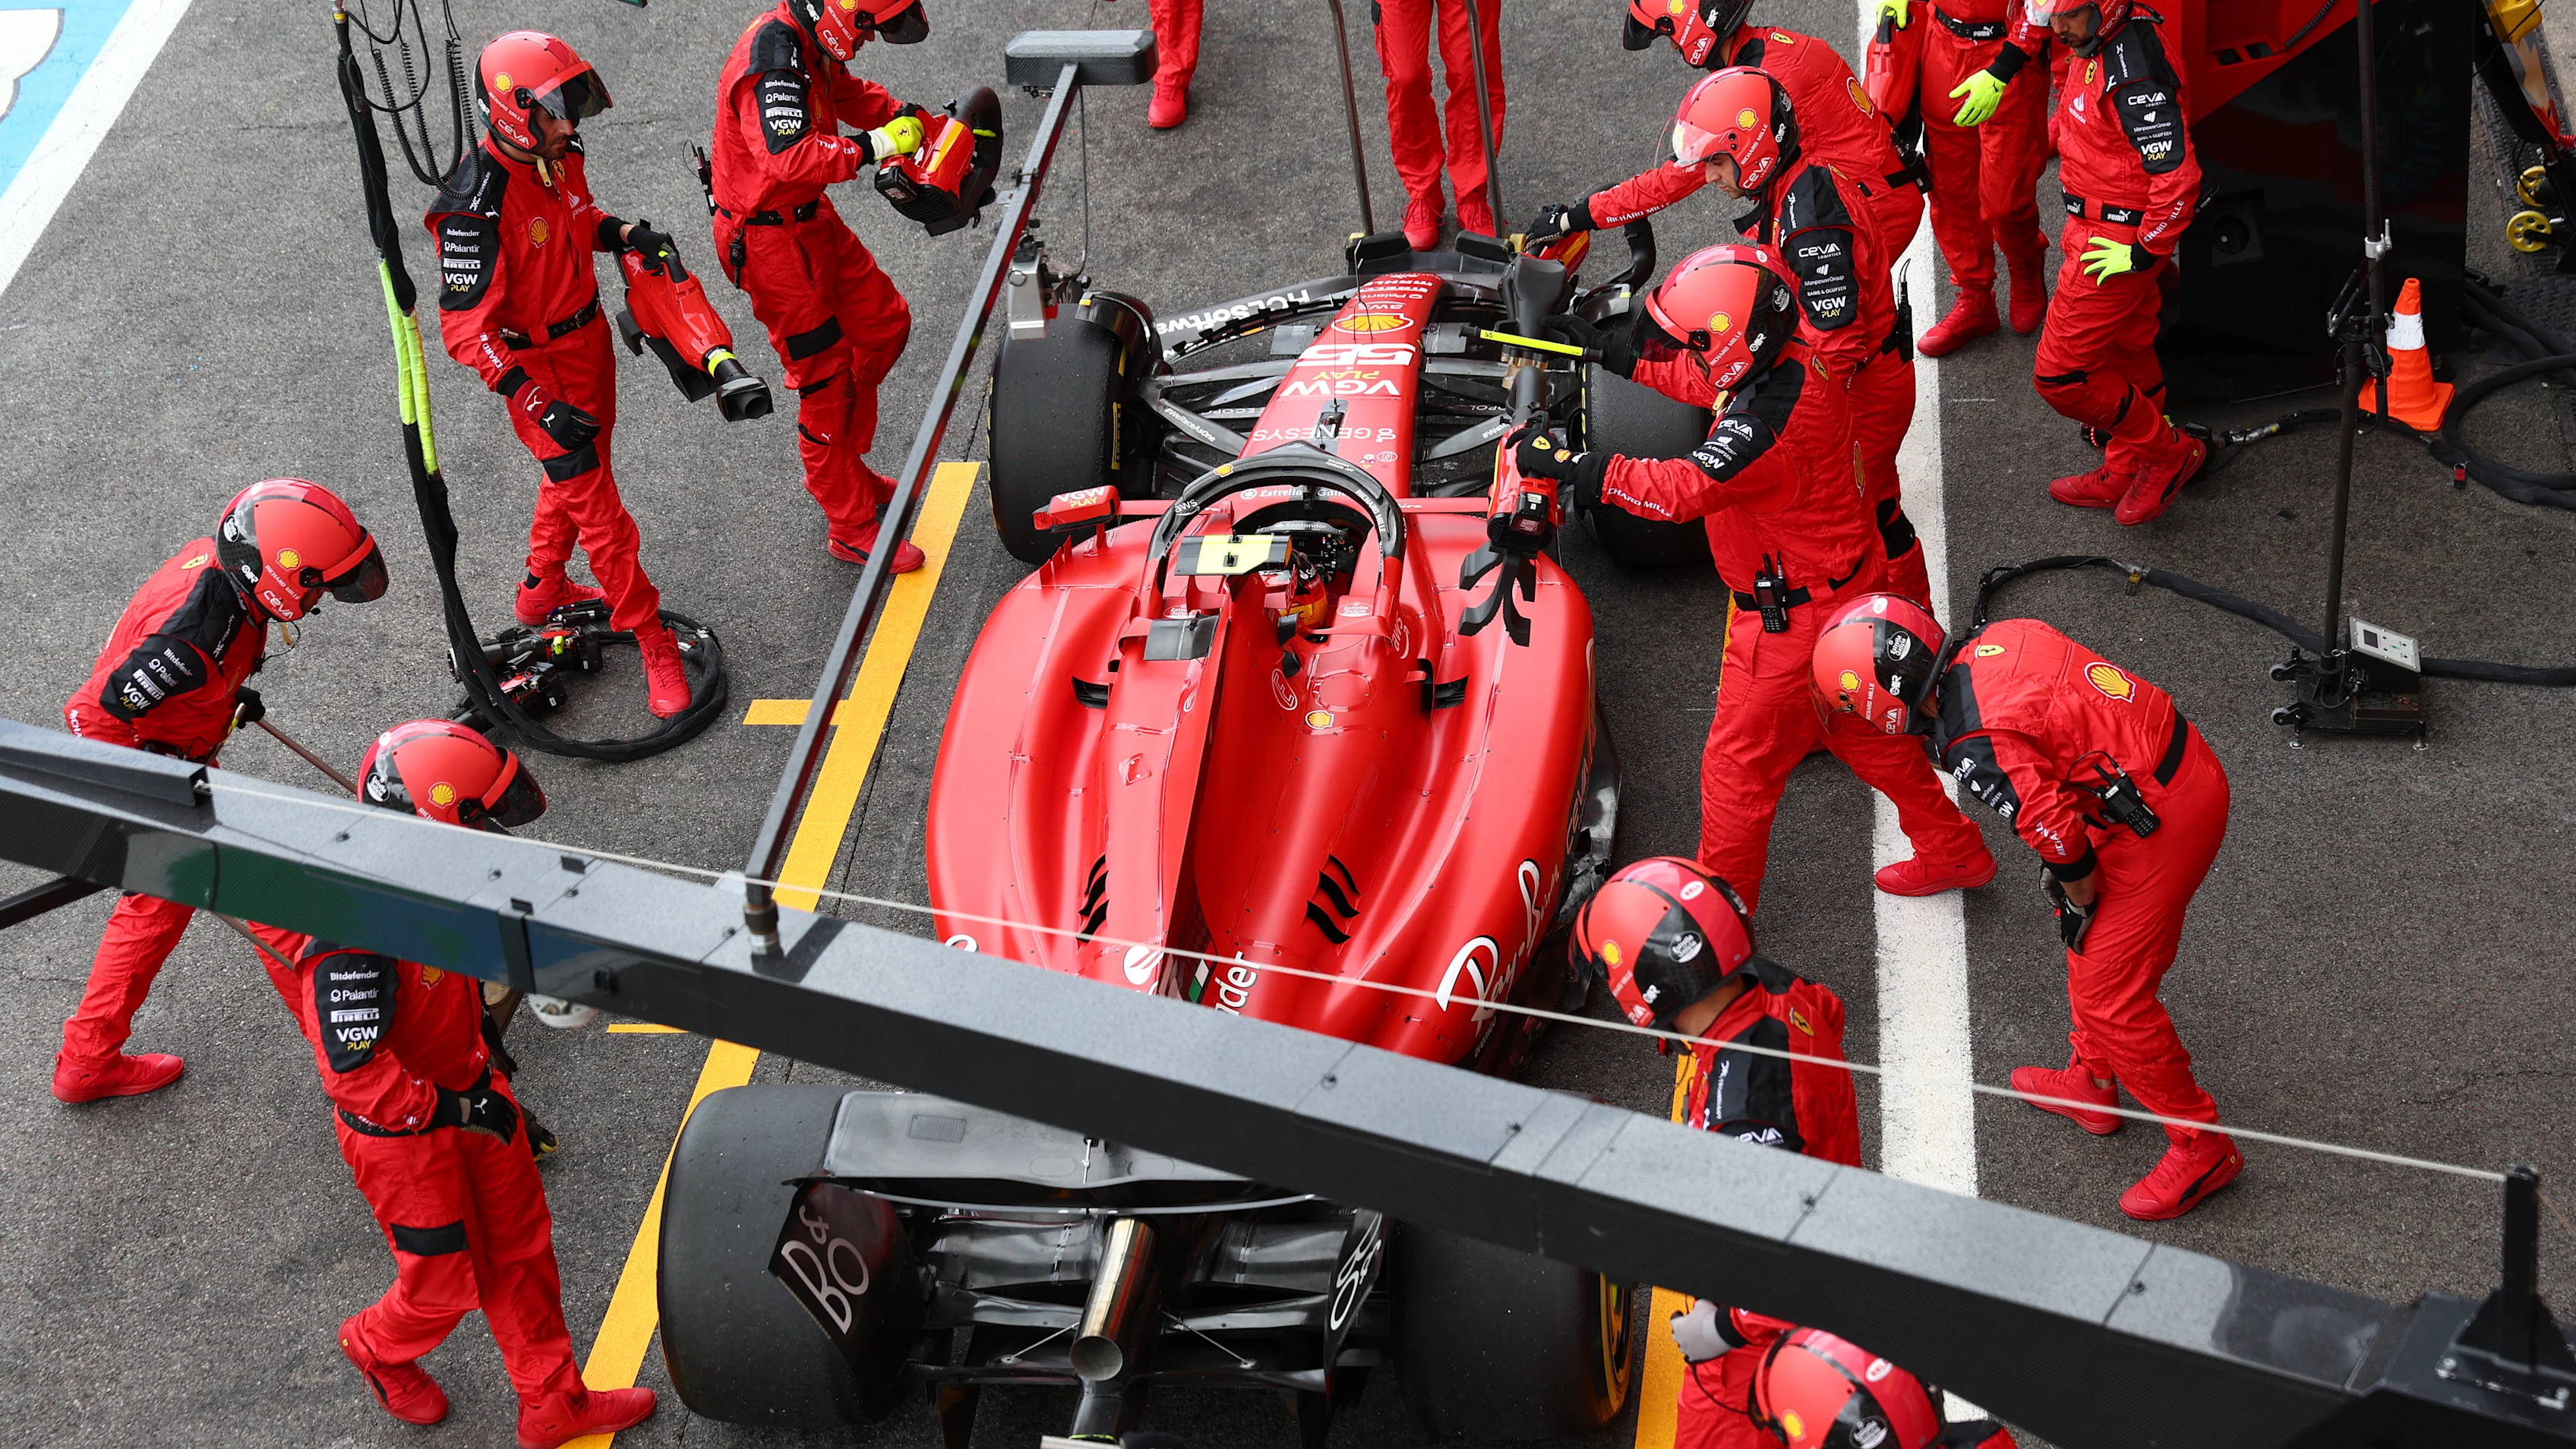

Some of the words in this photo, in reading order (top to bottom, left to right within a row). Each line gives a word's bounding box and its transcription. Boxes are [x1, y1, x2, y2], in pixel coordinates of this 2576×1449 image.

[1687, 9, 1697, 26] MILLE
[841, 27, 854, 41] MILLE
[765, 80, 801, 90] Bitdefender
[508, 110, 526, 124] MILLE
[766, 106, 803, 118] PIRELLI
[769, 119, 802, 131] VGW
[778, 128, 796, 136] PLAY
[2133, 122, 2171, 133] ManpowerGroup
[2152, 131, 2173, 139] OLUFSEN
[1740, 141, 1759, 166] RICHARD
[1757, 124, 1768, 141] MILLE
[2141, 140, 2173, 155] VGW
[2148, 152, 2167, 161] PLAY
[1606, 211, 1644, 223] RICHARD
[2107, 213, 2126, 222] PUMA
[450, 244, 480, 253] Palantir
[1817, 251, 1842, 260] LOGISTICS
[443, 257, 481, 270] PIRELLI
[444, 273, 478, 285] VGW
[1804, 274, 1845, 287] ManpowerGroup
[450, 284, 471, 292] PLAY
[1825, 285, 1847, 294] OLUFSEN
[1811, 296, 1846, 311] VGW
[1157, 289, 1310, 334] HCLSoftwa
[1821, 308, 1841, 319] PLAY
[1296, 343, 1416, 367] 55
[1709, 346, 1730, 366] RICHARD
[1728, 330, 1743, 347] MILLE
[1312, 371, 1380, 380] PLAY
[1280, 380, 1400, 396] VGW
[1164, 408, 1217, 443] #WeRaceAsOne
[1252, 425, 1372, 442] GENESYS
[1728, 427, 1751, 442] LOGISTICS
[1693, 450, 1725, 469] VGW
[1711, 447, 1733, 461] OLUFSEN
[1056, 486, 1105, 503] VGW
[1259, 488, 1303, 497] Estrella
[1070, 497, 1097, 508] PLAY
[1174, 499, 1198, 513] aws
[1643, 500, 1673, 517] MILLE
[1355, 489, 1380, 515] RICHARD
[1375, 513, 1387, 532] MILLE
[265, 565, 286, 588] RICHARD
[285, 586, 301, 600] MILLE
[1392, 615, 1403, 652] aws
[132, 668, 166, 700] PIRELLI
[123, 682, 151, 709] VGW
[119, 695, 138, 711] PLAY
[70, 709, 82, 737] RICHA
[1684, 884, 1701, 897] BELL
[330, 970, 380, 981] Bitdefender
[342, 987, 380, 1001] Palantir
[330, 1008, 380, 1023] PIRELLI
[336, 1025, 378, 1043] VGW
[347, 1040, 371, 1051] PLAY
[781, 1204, 870, 1335] B&O
